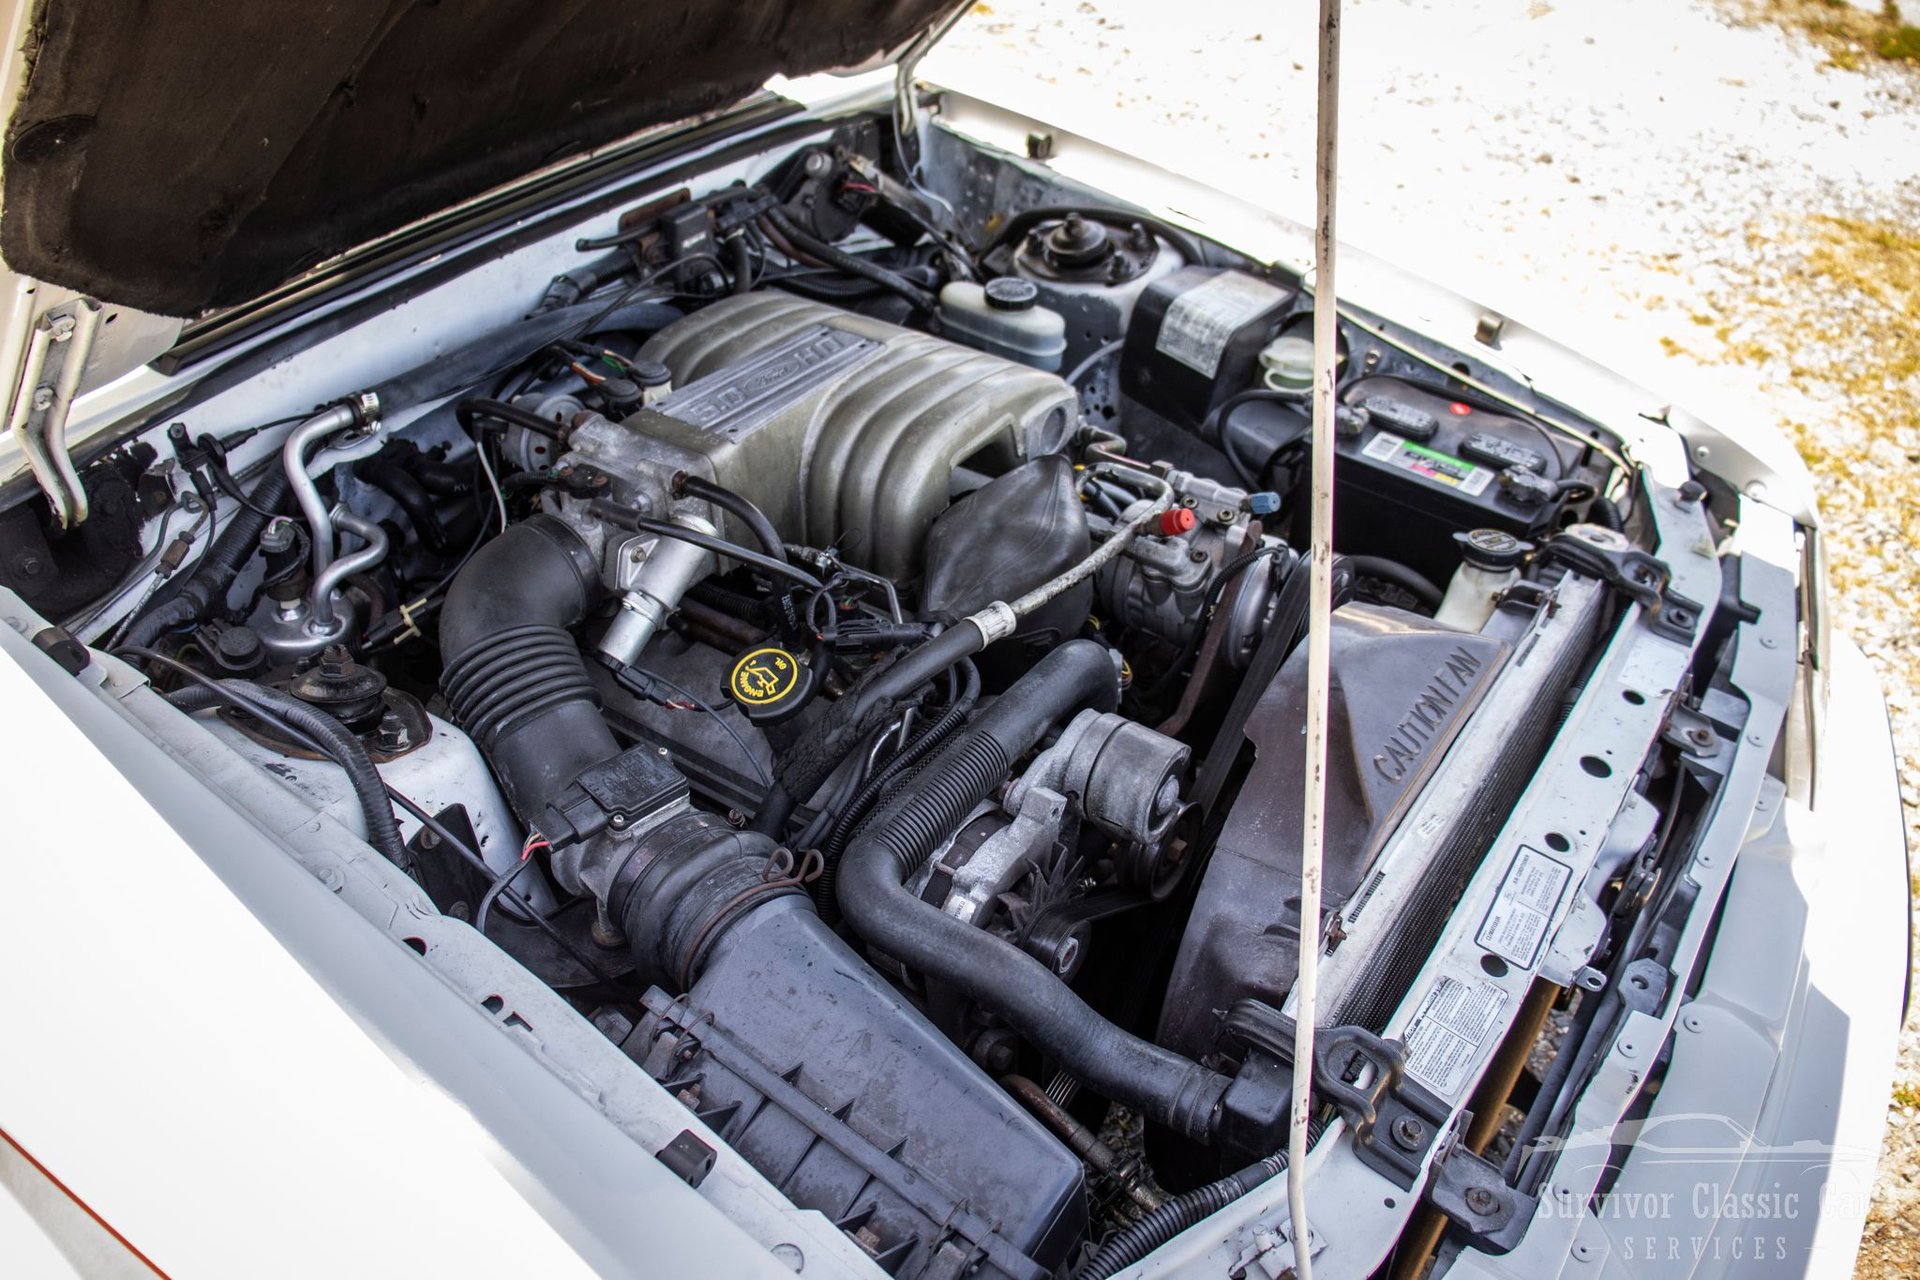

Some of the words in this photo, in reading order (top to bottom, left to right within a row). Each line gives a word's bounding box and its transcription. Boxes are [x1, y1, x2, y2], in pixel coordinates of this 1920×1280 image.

[740, 671, 764, 697] ENGINE
[774, 657, 787, 670] OIL
[1373, 683, 1453, 781] CAUTION
[1432, 645, 1481, 697] FAN
